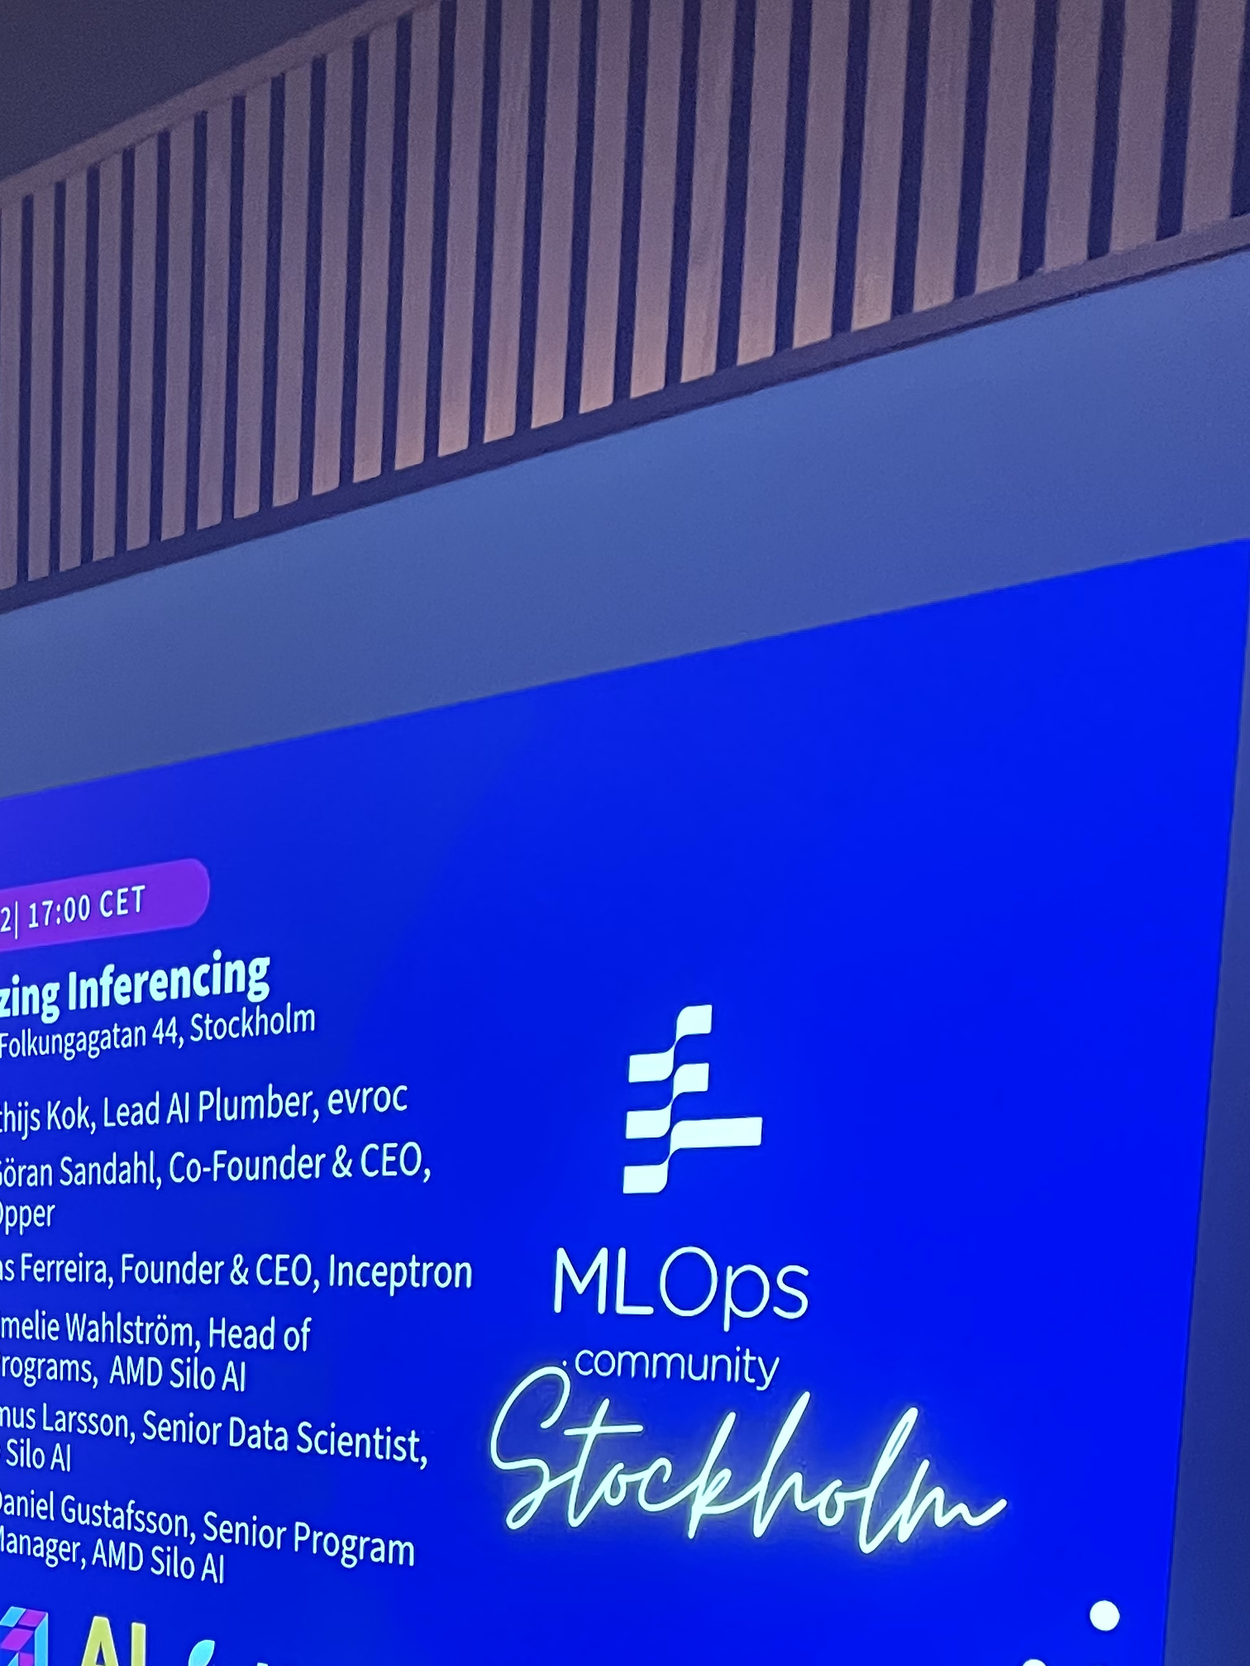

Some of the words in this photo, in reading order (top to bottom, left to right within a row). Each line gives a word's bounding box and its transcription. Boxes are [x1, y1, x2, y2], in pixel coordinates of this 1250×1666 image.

[28, 894, 91, 929] 17:00
[99, 884, 146, 918] CET
[68, 948, 271, 1011] Inferencing
[151, 1015, 185, 1050] 44,
[189, 1001, 316, 1042] Stockholm
[47, 1095, 97, 1135] Kok,
[103, 1090, 160, 1128] Lead
[166, 1091, 190, 1125] AI
[198, 1082, 320, 1124] Plumber,
[327, 1084, 408, 1116] evroc
[59, 1150, 162, 1191] Sandahl,
[169, 1143, 327, 1184] Co-Founder
[331, 1144, 353, 1179] &
[360, 1141, 431, 1184] CEO,
[20, 1251, 114, 1290] Ferreira,
[121, 1250, 225, 1285] Founder
[229, 1253, 249, 1286] &
[255, 1253, 320, 1294] CEO,
[328, 1253, 473, 1297] Inceptron
[553, 1245, 809, 1333] MLOps
[65, 1310, 201, 1354] Wahlström,
[209, 1315, 276, 1351] Head
[283, 1316, 313, 1352] of
[108, 1354, 163, 1387] AMD
[169, 1356, 216, 1391] Silo
[221, 1360, 246, 1393] AI
[574, 1345, 780, 1392] community
[5, 1437, 46, 1470] Silo
[49, 1442, 71, 1473] AI
[42, 1402, 136, 1445] Larsson,
[142, 1409, 223, 1446] Senior
[229, 1416, 289, 1452] Data
[296, 1420, 428, 1471] Scientist,
[489, 1366, 1008, 1555] Stockholm
[60, 1494, 196, 1546] Gustafsson,
[202, 1510, 288, 1551] Senior
[294, 1521, 415, 1569] Program
[91, 1537, 144, 1572] AMD
[150, 1545, 196, 1580] Silo
[200, 1552, 224, 1584] AI
